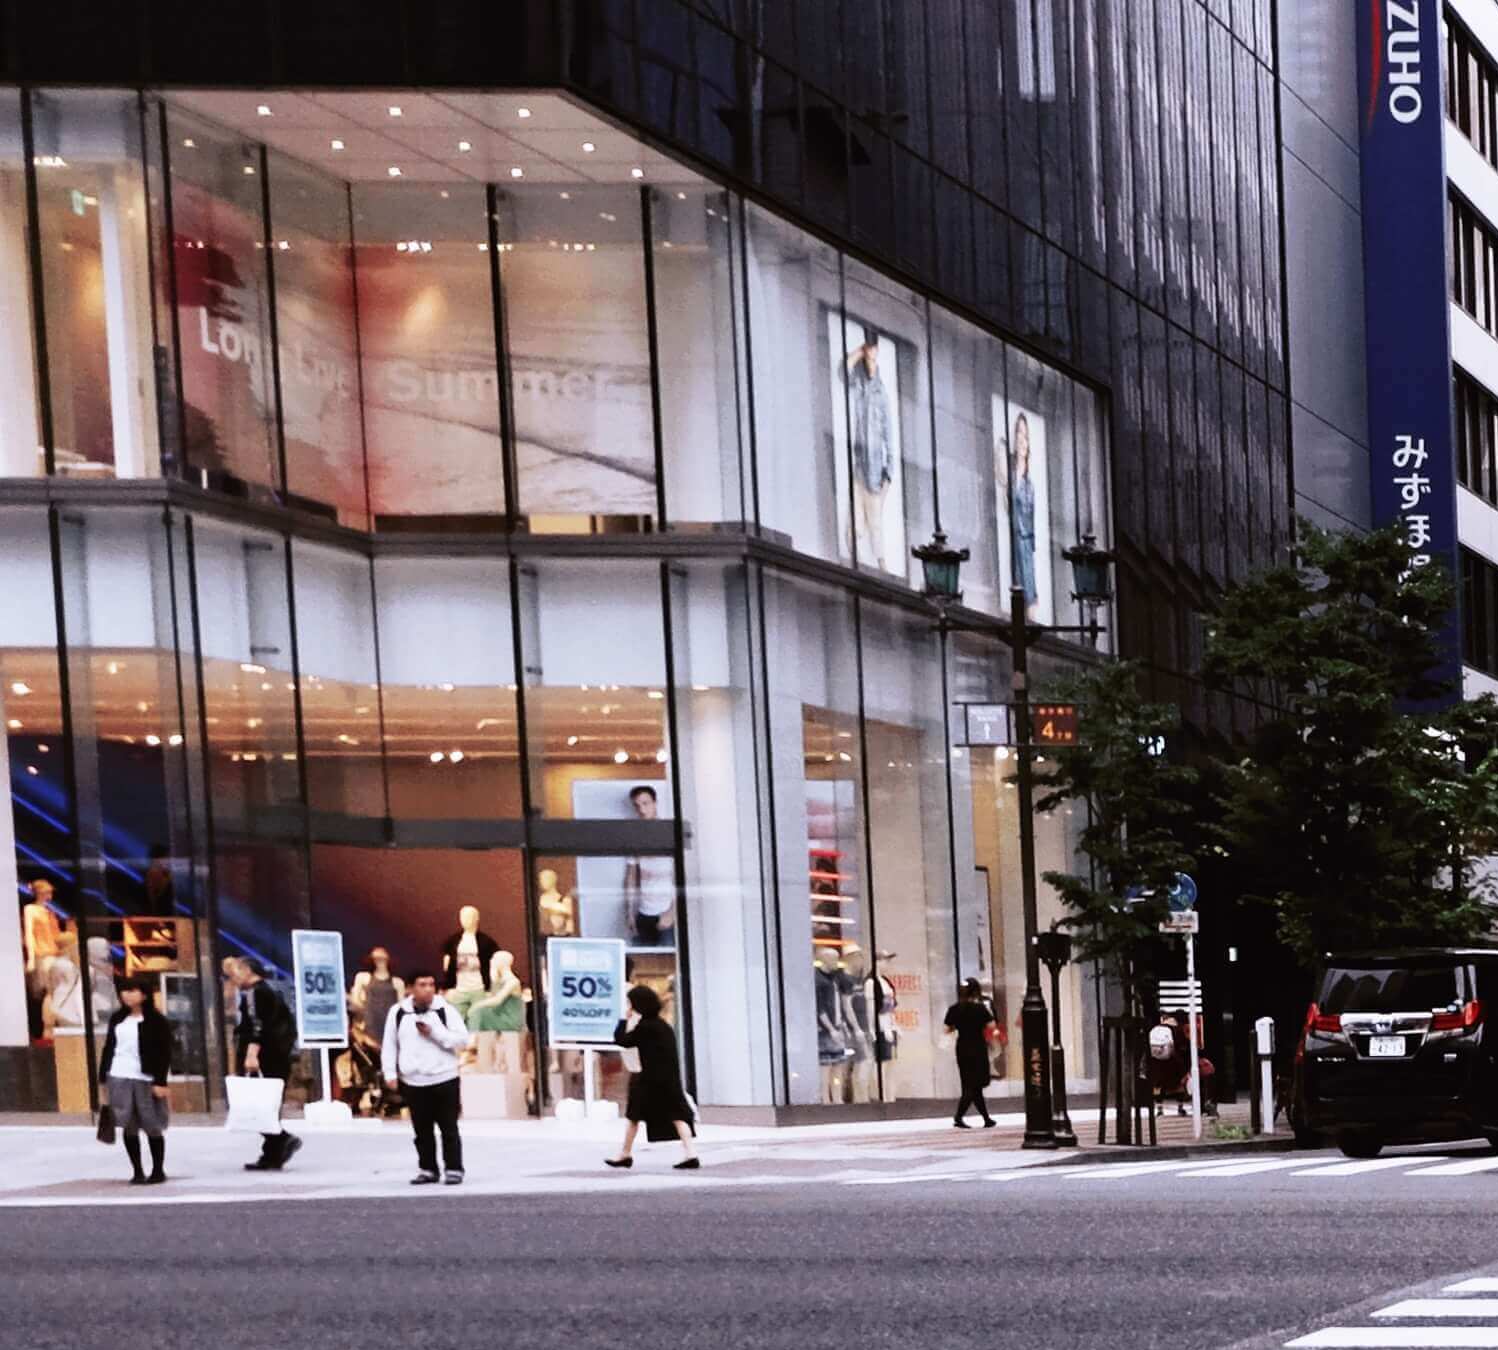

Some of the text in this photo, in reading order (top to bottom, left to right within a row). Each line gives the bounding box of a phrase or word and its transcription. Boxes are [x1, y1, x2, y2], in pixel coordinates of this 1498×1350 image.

[1387, 0, 1422, 123] ZUHO
[1393, 434, 1432, 596] みずほ
[561, 976, 613, 998] 50%
